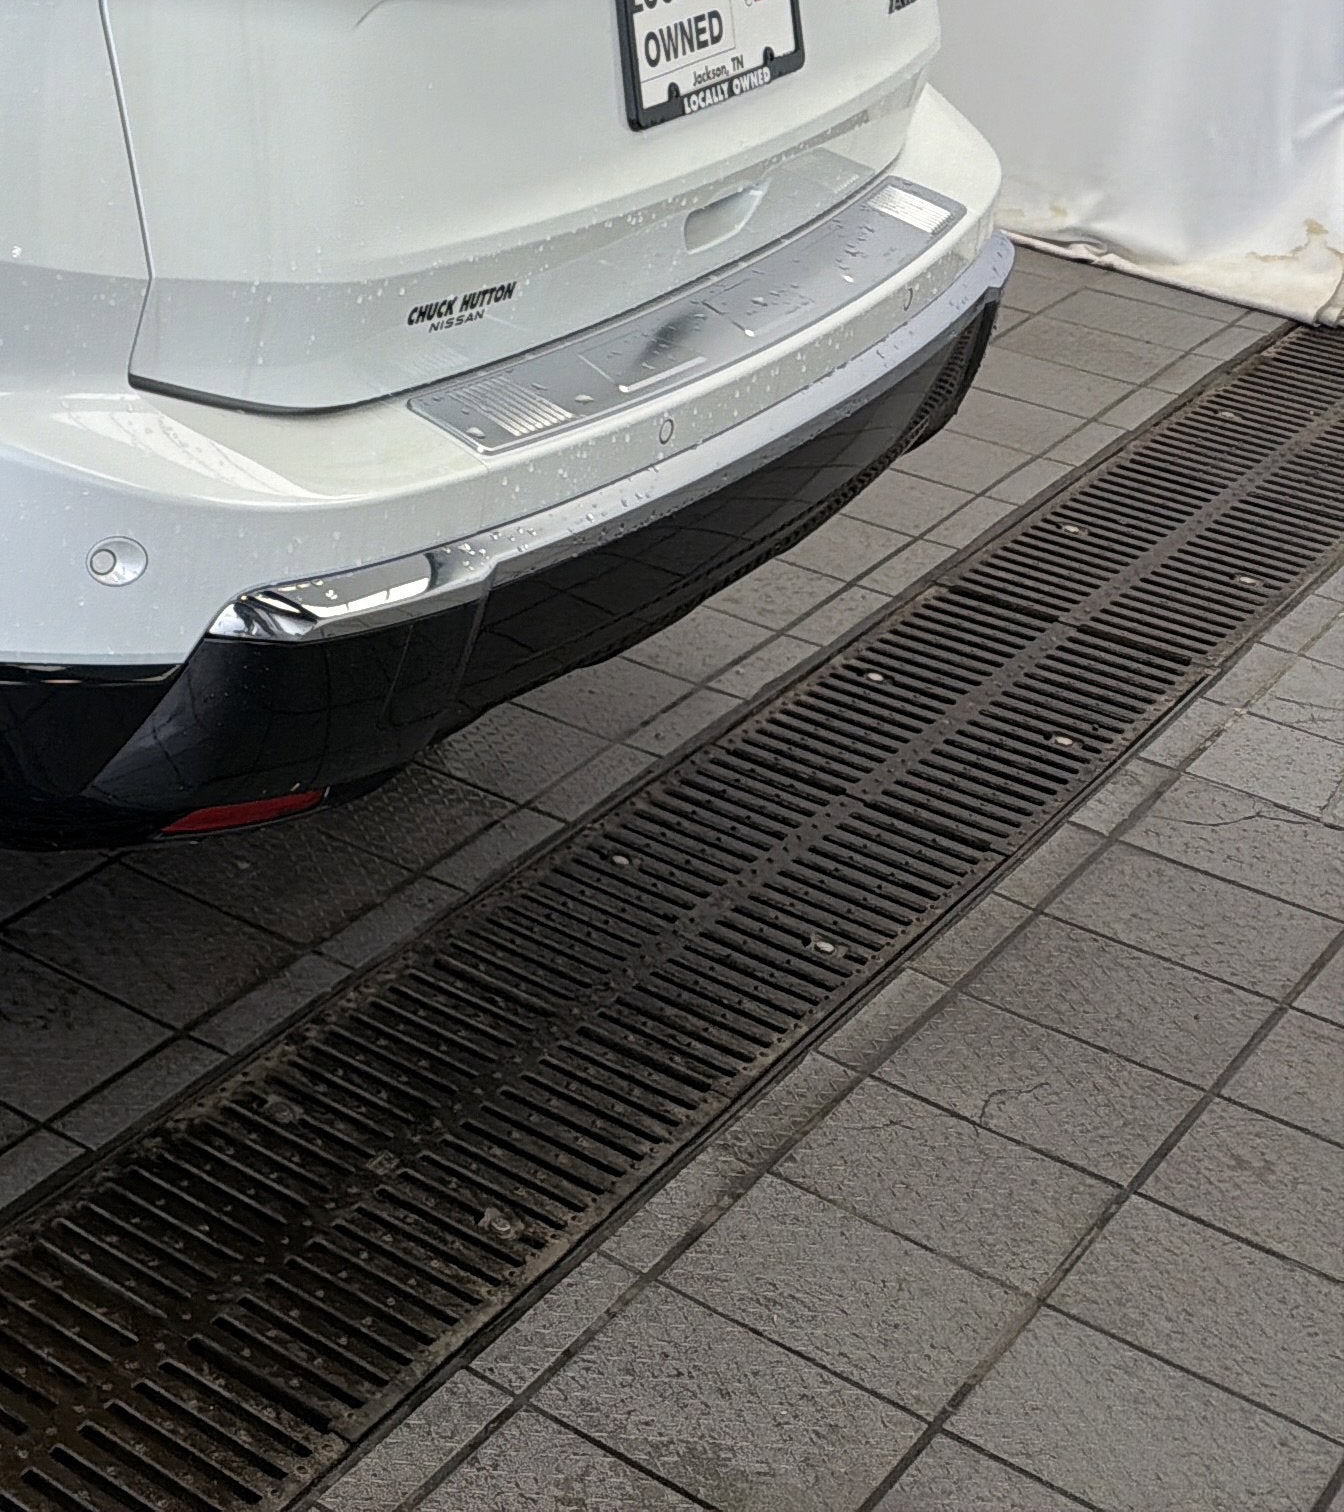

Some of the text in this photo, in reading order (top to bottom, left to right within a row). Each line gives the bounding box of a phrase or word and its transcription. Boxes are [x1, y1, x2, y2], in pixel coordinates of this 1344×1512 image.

[644, 9, 724, 68] OWNED
[683, 66, 772, 115] LOCALLY OWNED
[692, 54, 745, 87] Jackson, TN
[407, 281, 517, 326] CHUCK HUTTON
[428, 309, 485, 333] NISSAN
